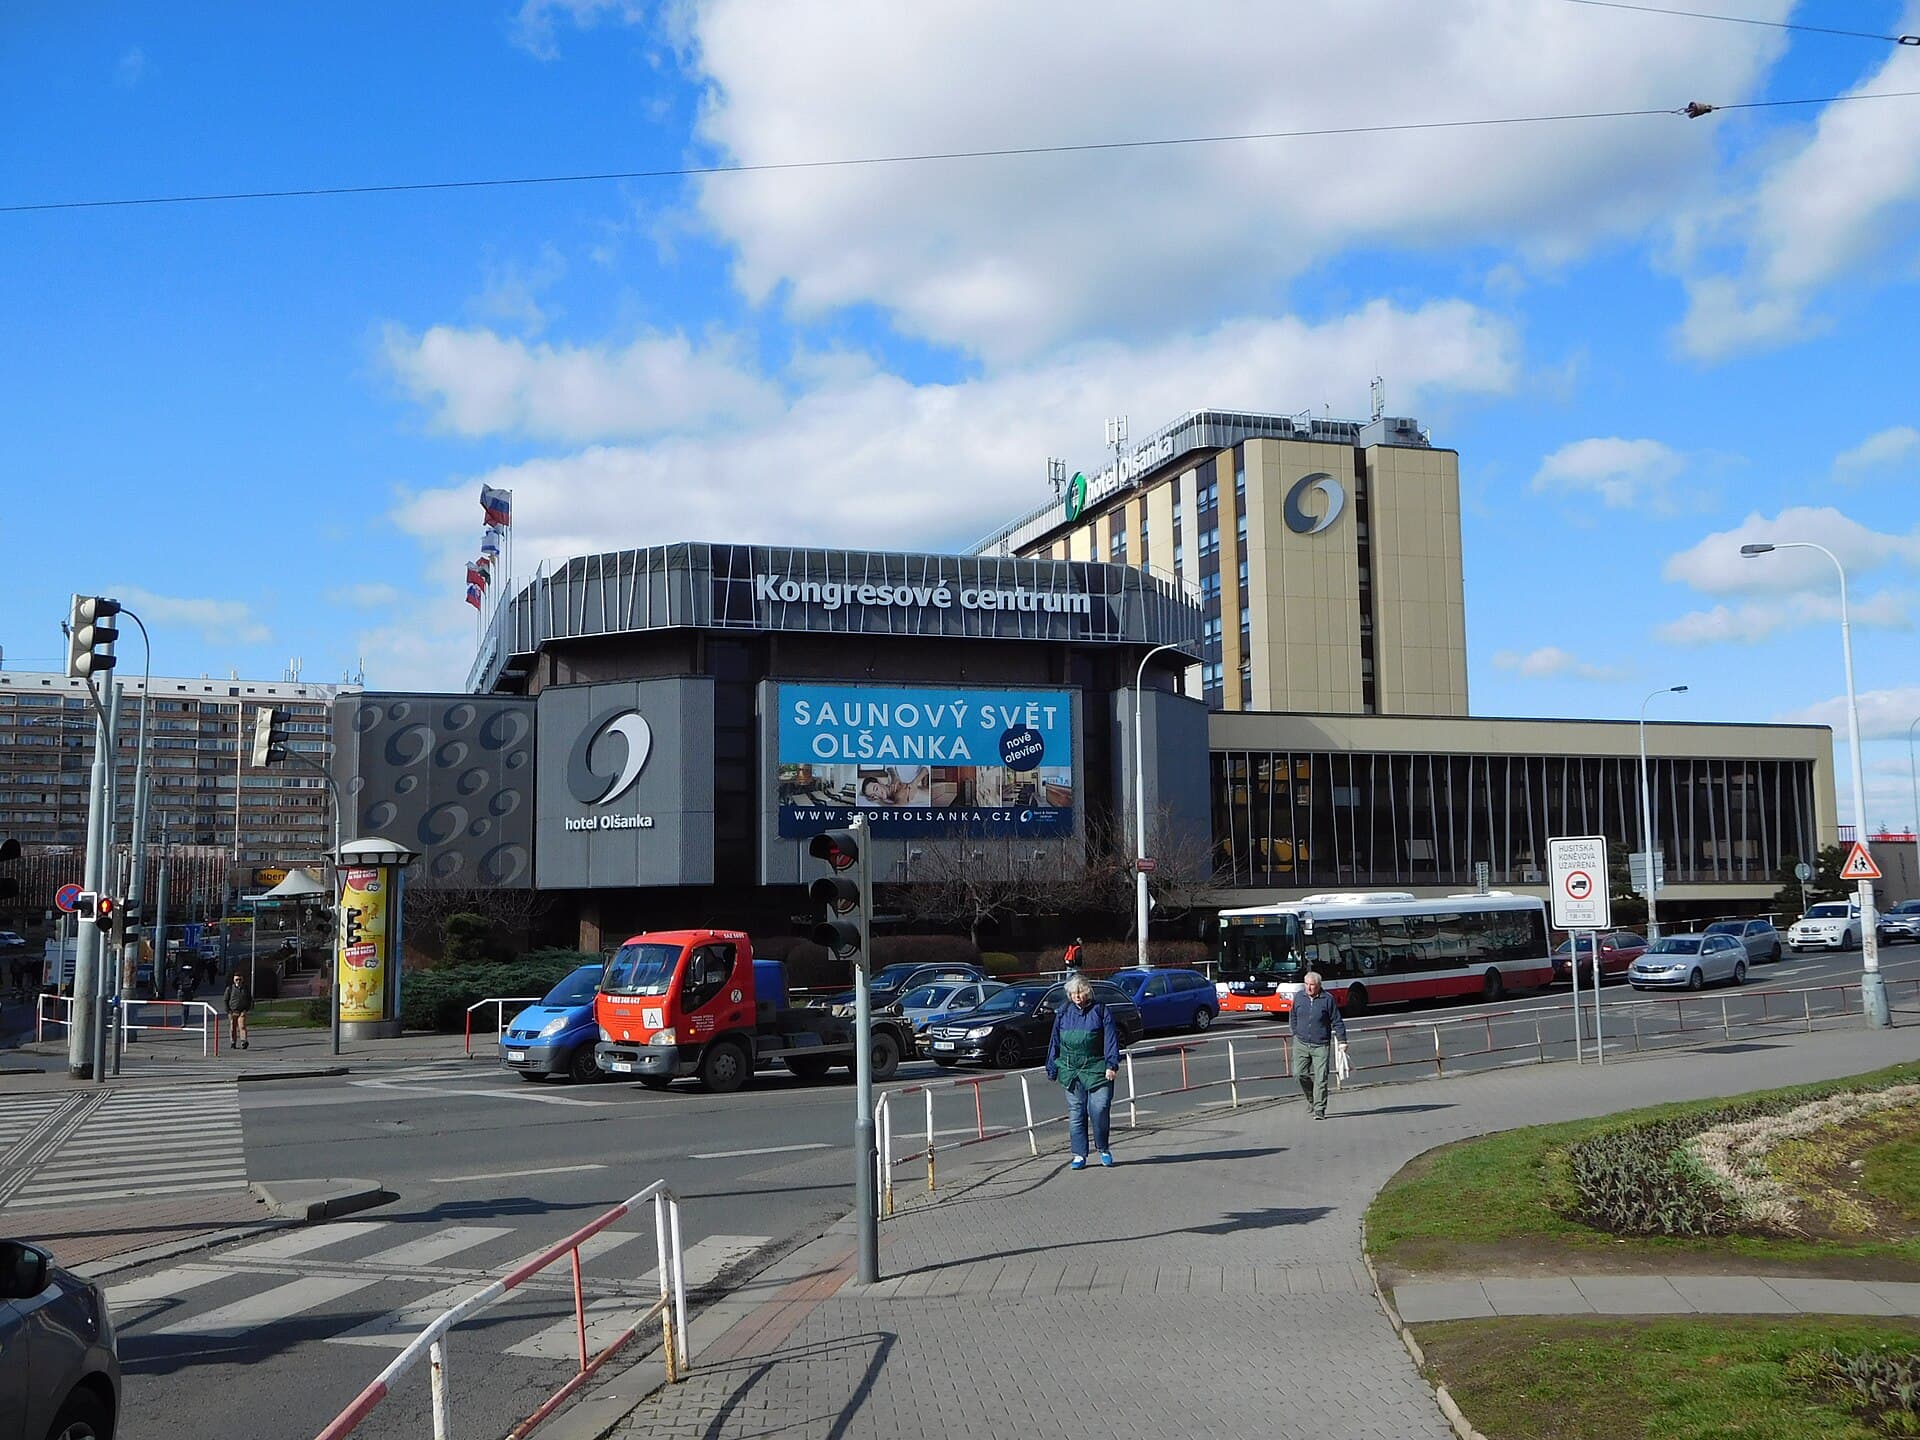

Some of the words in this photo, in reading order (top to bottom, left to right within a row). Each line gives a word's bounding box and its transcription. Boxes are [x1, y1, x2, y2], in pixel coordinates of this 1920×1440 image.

[1085, 463, 1117, 503] hotel
[756, 574, 951, 610] Kongresové
[960, 586, 1091, 613] centrum
[794, 700, 968, 729] SAUNOVÝ
[980, 702, 1057, 730] SVĚT
[812, 730, 972, 760] OLŠANKA
[1006, 732, 1032, 749] nově
[565, 816, 597, 830] hotel
[600, 814, 653, 829] Olšanka
[647, 1012, 659, 1027] A
